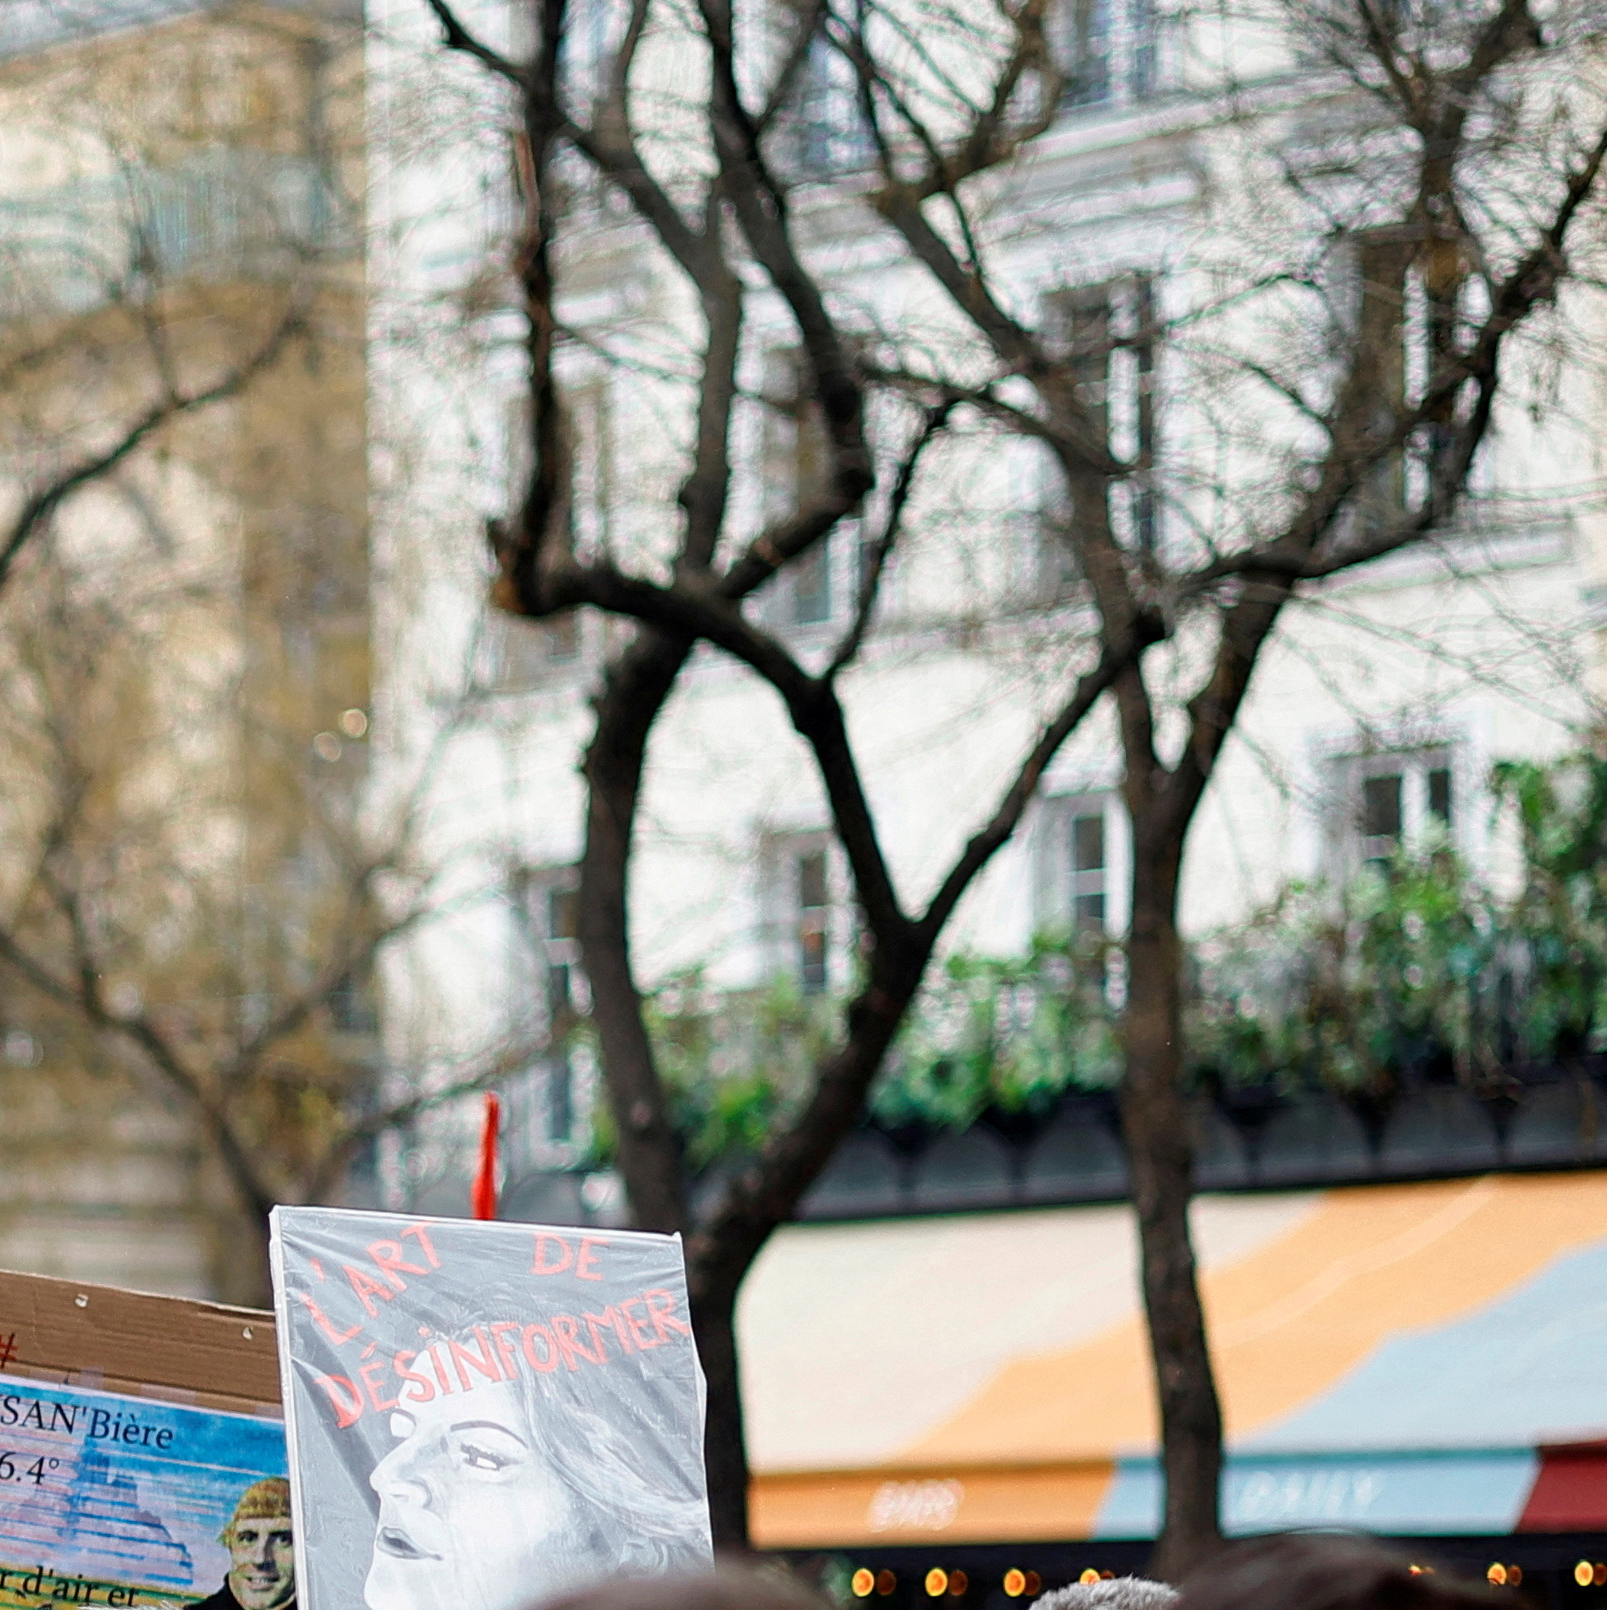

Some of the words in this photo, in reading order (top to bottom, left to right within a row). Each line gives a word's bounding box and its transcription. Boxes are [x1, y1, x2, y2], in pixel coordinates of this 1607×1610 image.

[299, 1220, 444, 1347] L'ART
[530, 1231, 611, 1281] DE
[313, 1287, 689, 1429] DÉSINFORMER
[22, 1564, 102, 1601] d'air
[107, 1582, 139, 1607] et
